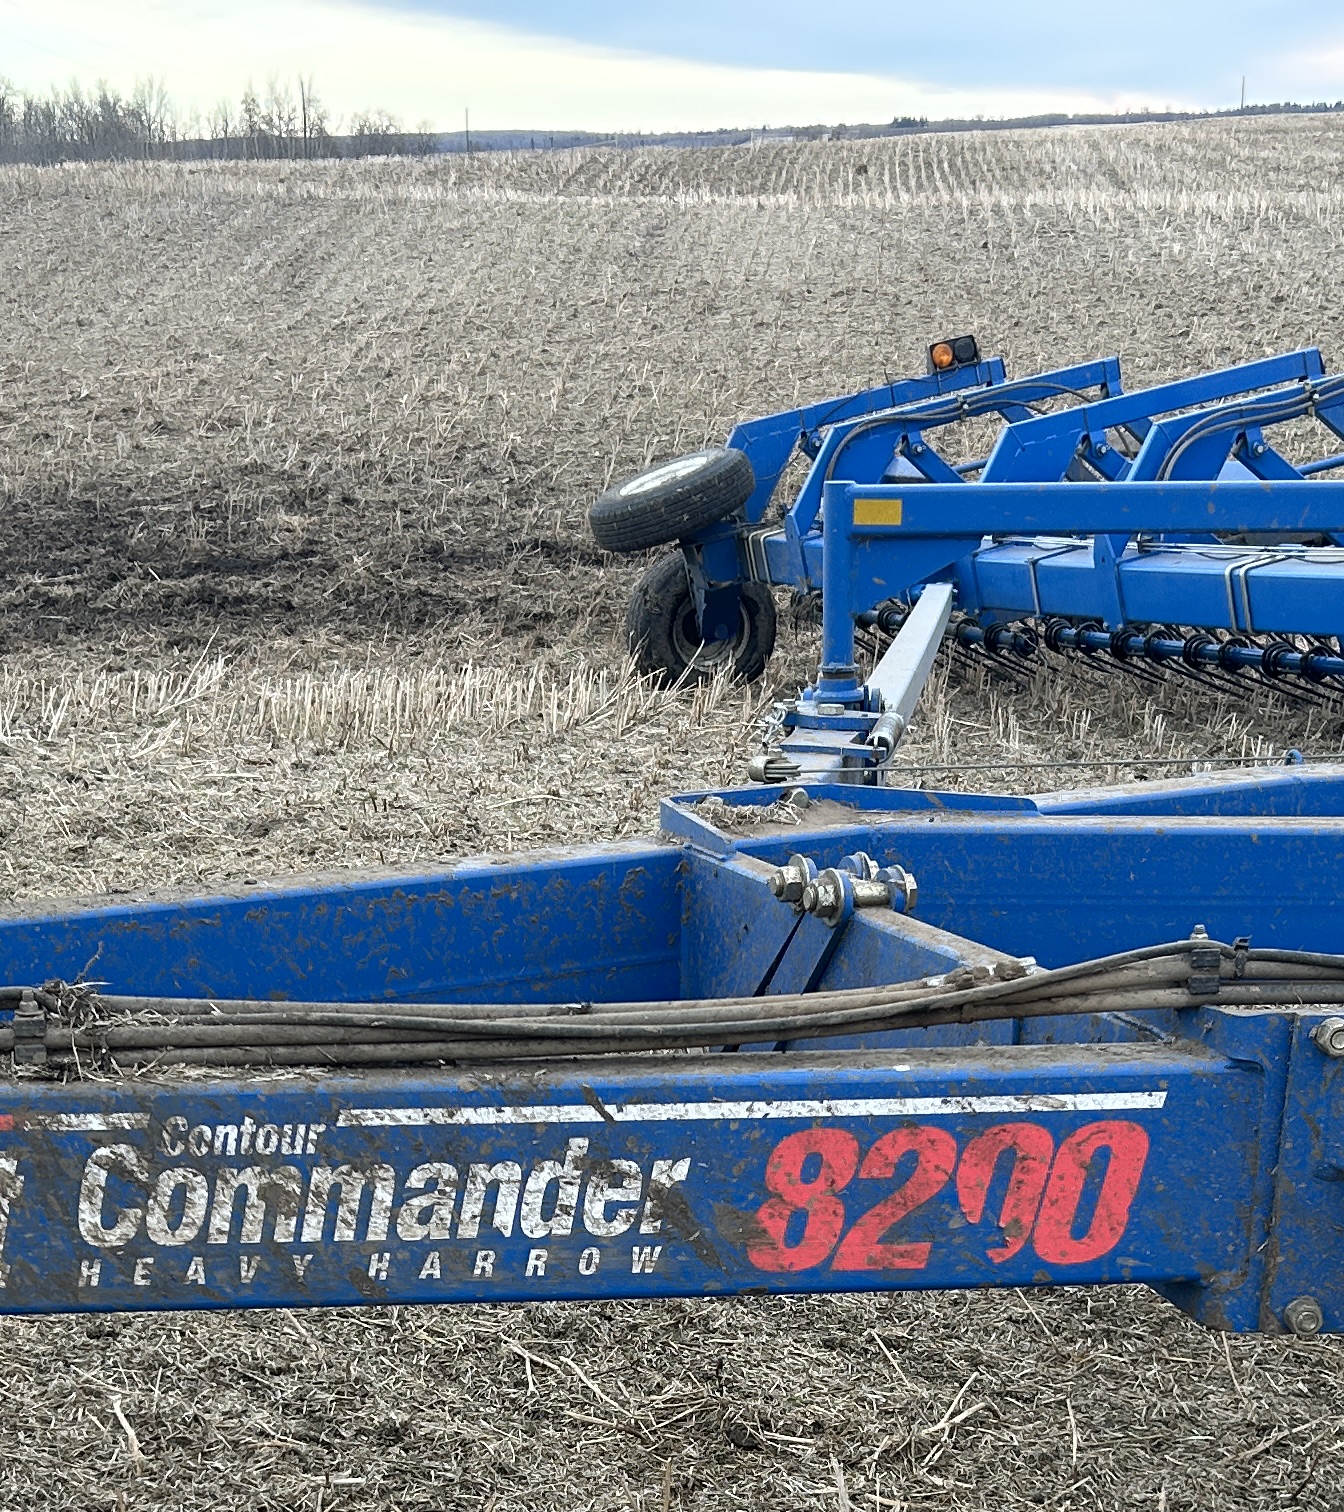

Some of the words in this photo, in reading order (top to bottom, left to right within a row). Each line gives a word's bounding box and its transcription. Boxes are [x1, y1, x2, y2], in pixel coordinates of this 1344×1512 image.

[161, 1114, 326, 1157] Contour
[78, 1137, 691, 1247] Commander
[747, 1119, 1149, 1273] 8200
[78, 1252, 314, 1288] HEAVY
[368, 1245, 662, 1281] HARROW
